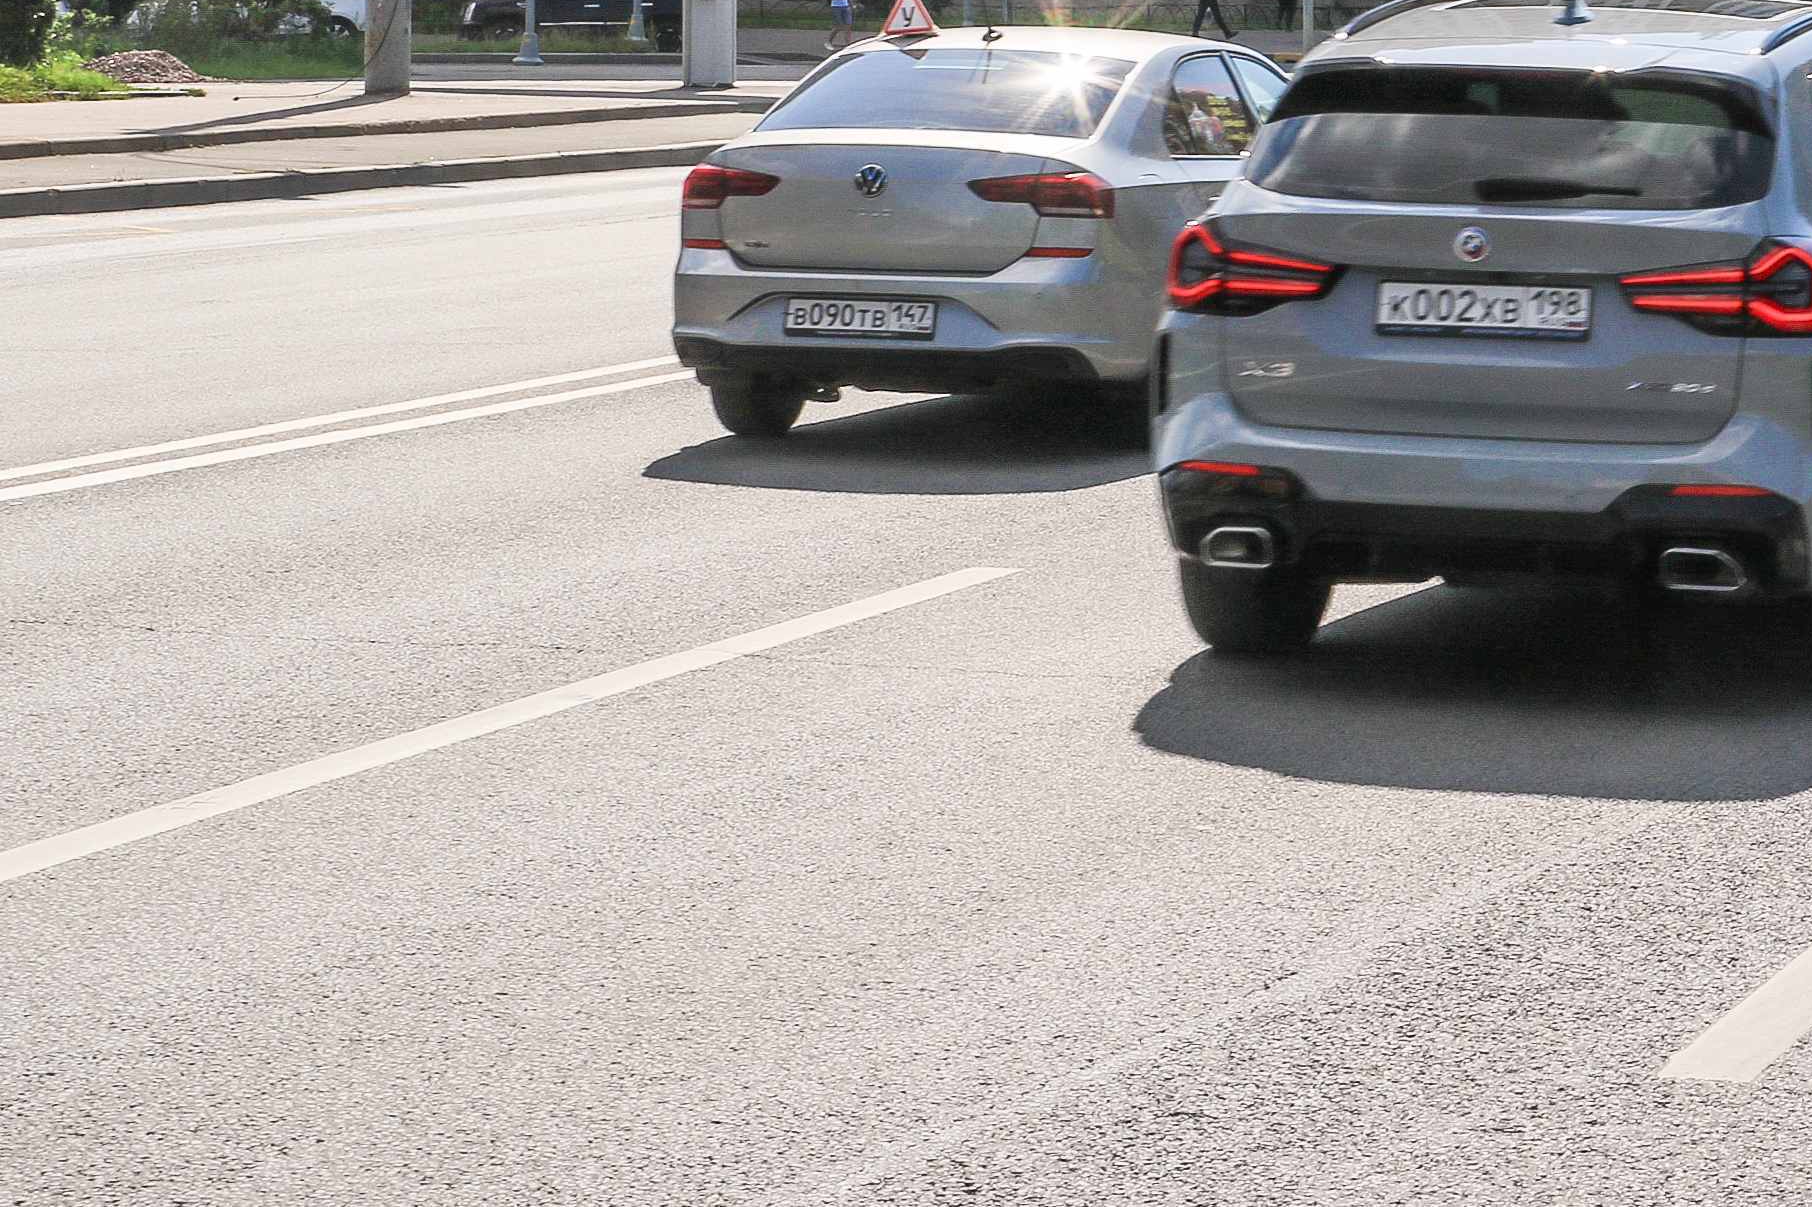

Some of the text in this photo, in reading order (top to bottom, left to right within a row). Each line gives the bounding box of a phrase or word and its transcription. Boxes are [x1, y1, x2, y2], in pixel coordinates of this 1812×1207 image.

[901, 6, 916, 27] У
[793, 302, 929, 328] В090ТВ 147
[1387, 289, 1582, 324] К002ХВ 198
